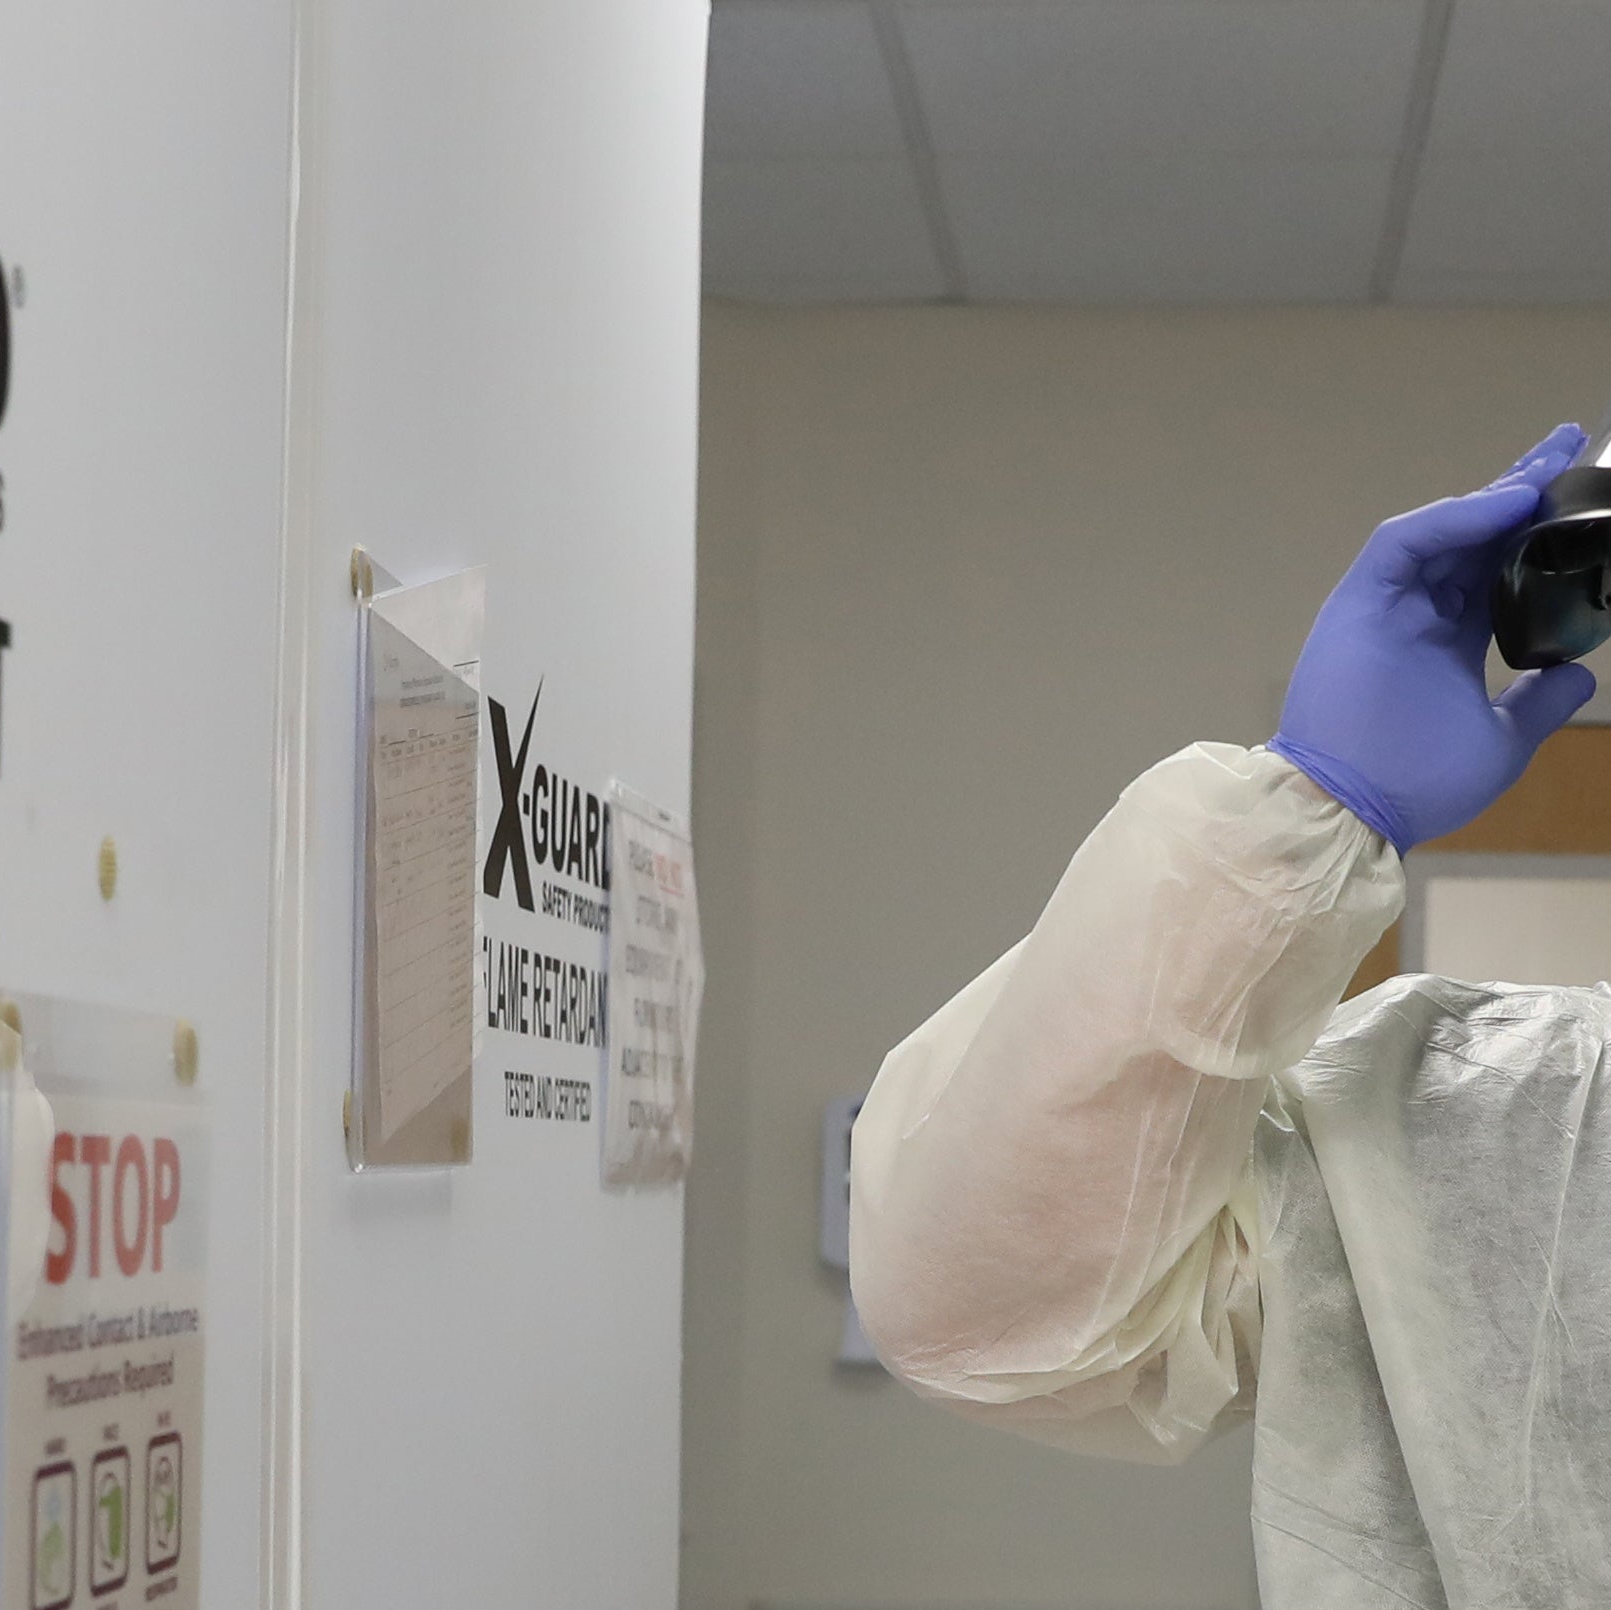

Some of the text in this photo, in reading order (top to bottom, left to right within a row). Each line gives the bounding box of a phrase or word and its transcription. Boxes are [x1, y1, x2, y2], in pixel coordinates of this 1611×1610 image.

[541, 879, 572, 923] SAFETY
[533, 951, 608, 1050] RETARDAN
[504, 1071, 535, 1119] TESTED
[536, 1075, 552, 1121] AND
[554, 1077, 592, 1123] CERTIFIED
[44, 1130, 181, 1286] STOP
